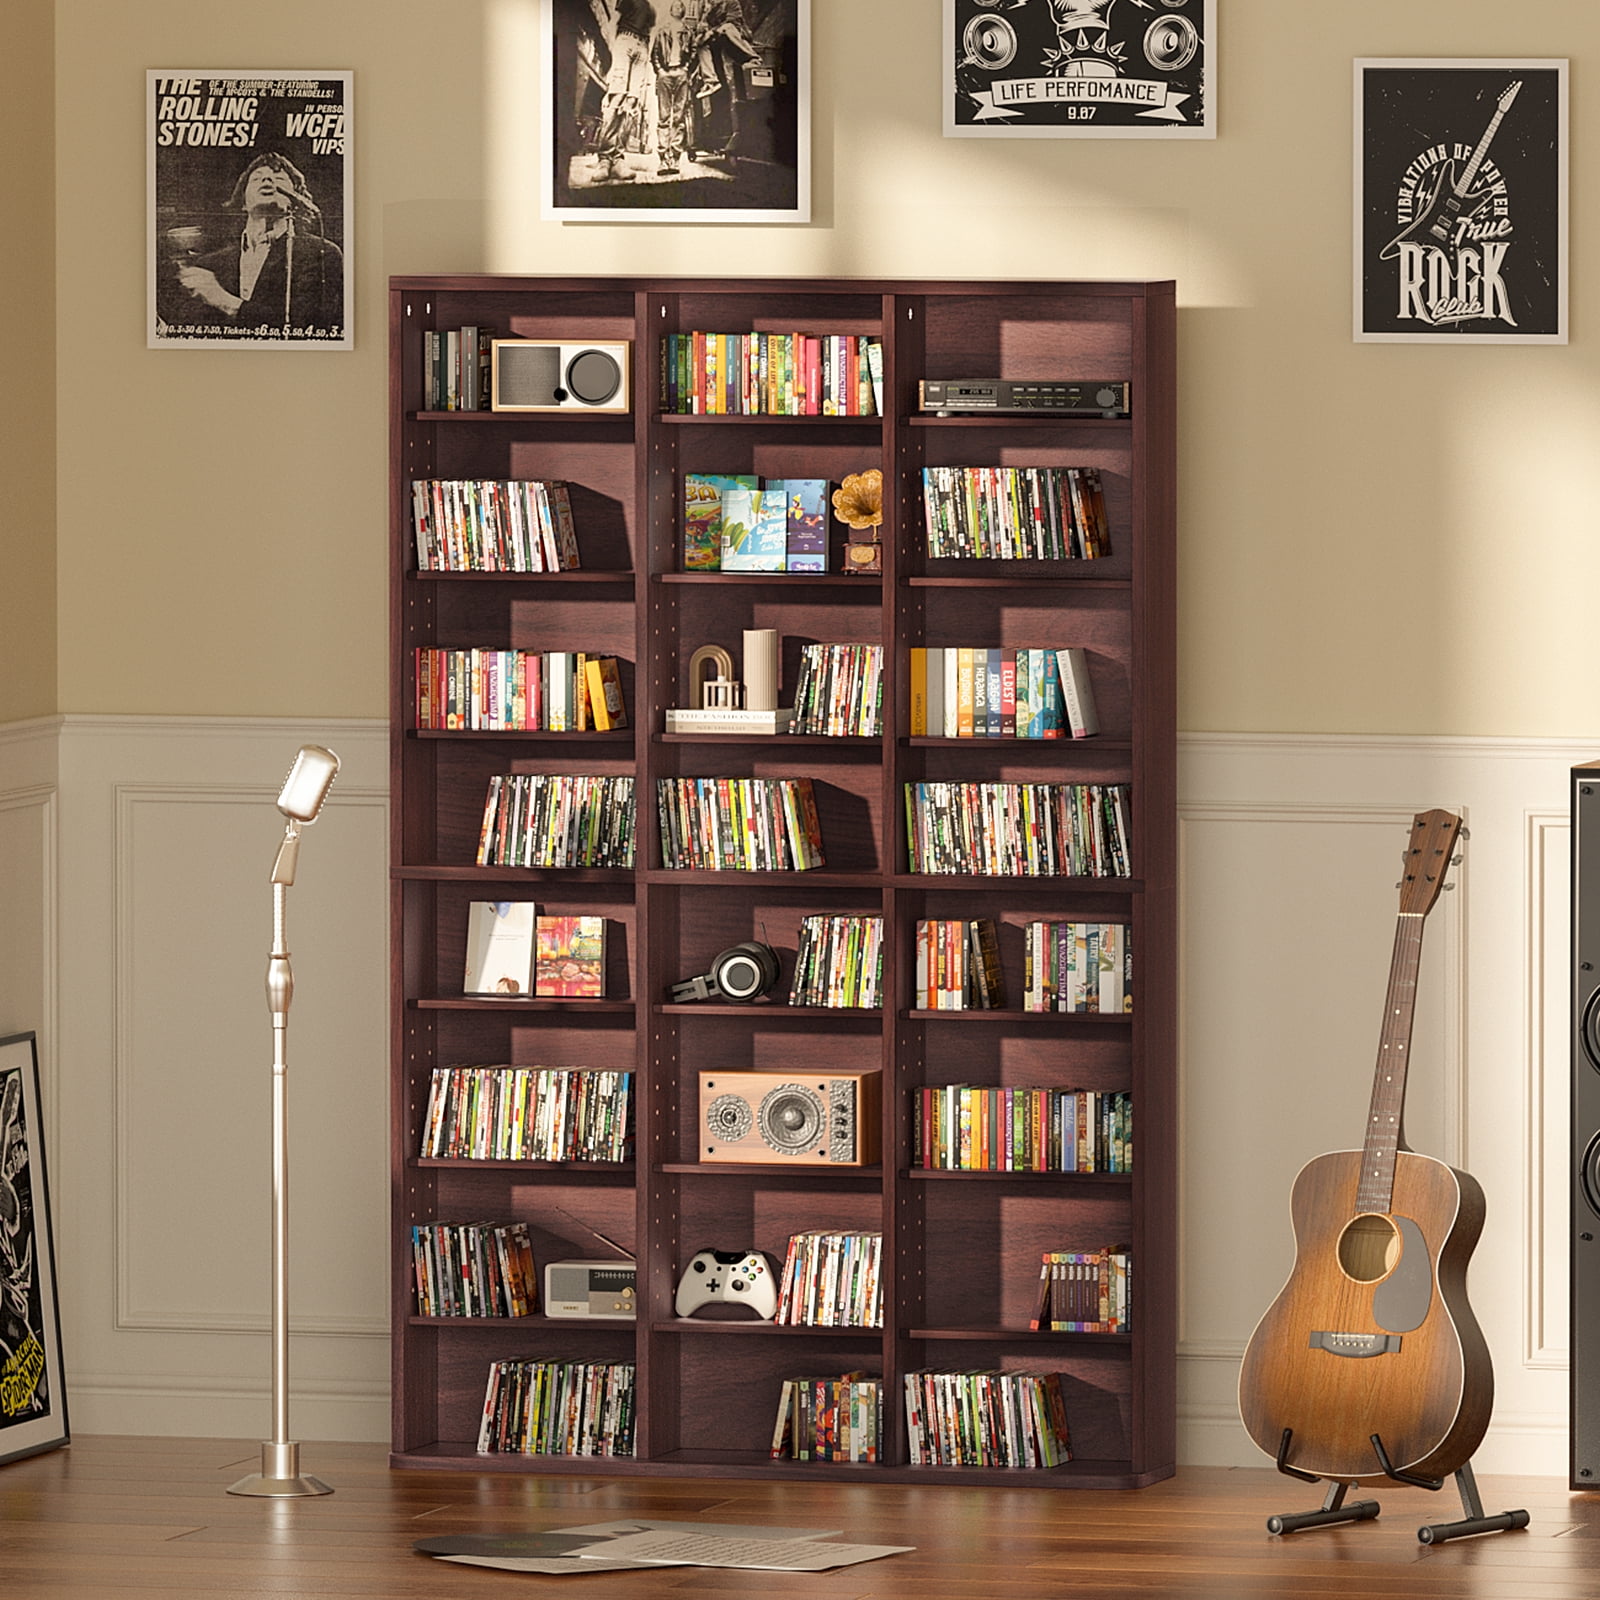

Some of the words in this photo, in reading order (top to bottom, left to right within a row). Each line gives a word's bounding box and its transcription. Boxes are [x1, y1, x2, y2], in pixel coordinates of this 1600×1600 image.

[1002, 82, 1036, 100] LIFE
[1045, 81, 1158, 101] PERFOMANCE
[158, 96, 259, 121] ROLLING
[304, 104, 314, 113] IN
[158, 122, 260, 147] STONES!
[1398, 144, 1448, 224] VIBRATIONS
[1453, 142, 1472, 161] OF
[1480, 158, 1508, 216] POWER
[1455, 216, 1514, 247] True
[1397, 241, 1518, 326] ROCK
[1431, 296, 1484, 320] Club
[1003, 669, 1015, 705] ELDEST
[1090, 936, 1099, 960] TATRY
